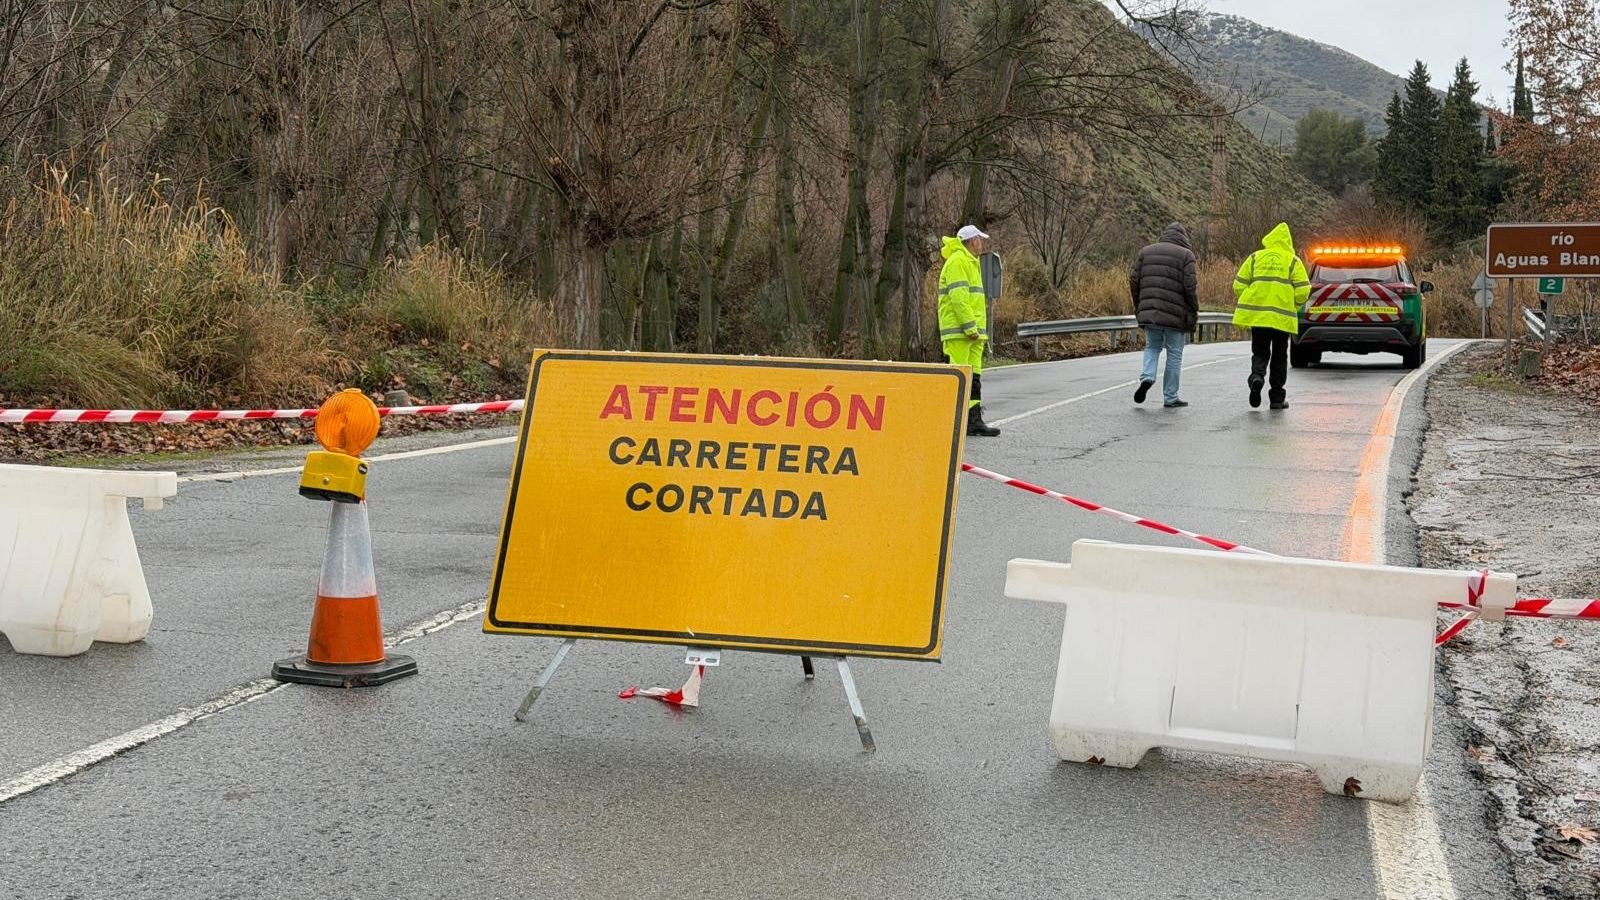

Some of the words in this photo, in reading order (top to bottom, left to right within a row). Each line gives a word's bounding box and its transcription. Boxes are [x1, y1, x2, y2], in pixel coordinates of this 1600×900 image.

[1551, 231, 1575, 246] río
[1494, 252, 1549, 269] Aguas
[1560, 252, 1600, 266] Blan
[1546, 279, 1556, 290] 2
[599, 384, 886, 431] ATENCIÓN
[608, 436, 860, 476] CARRETERA
[625, 482, 828, 521] CORTADA
